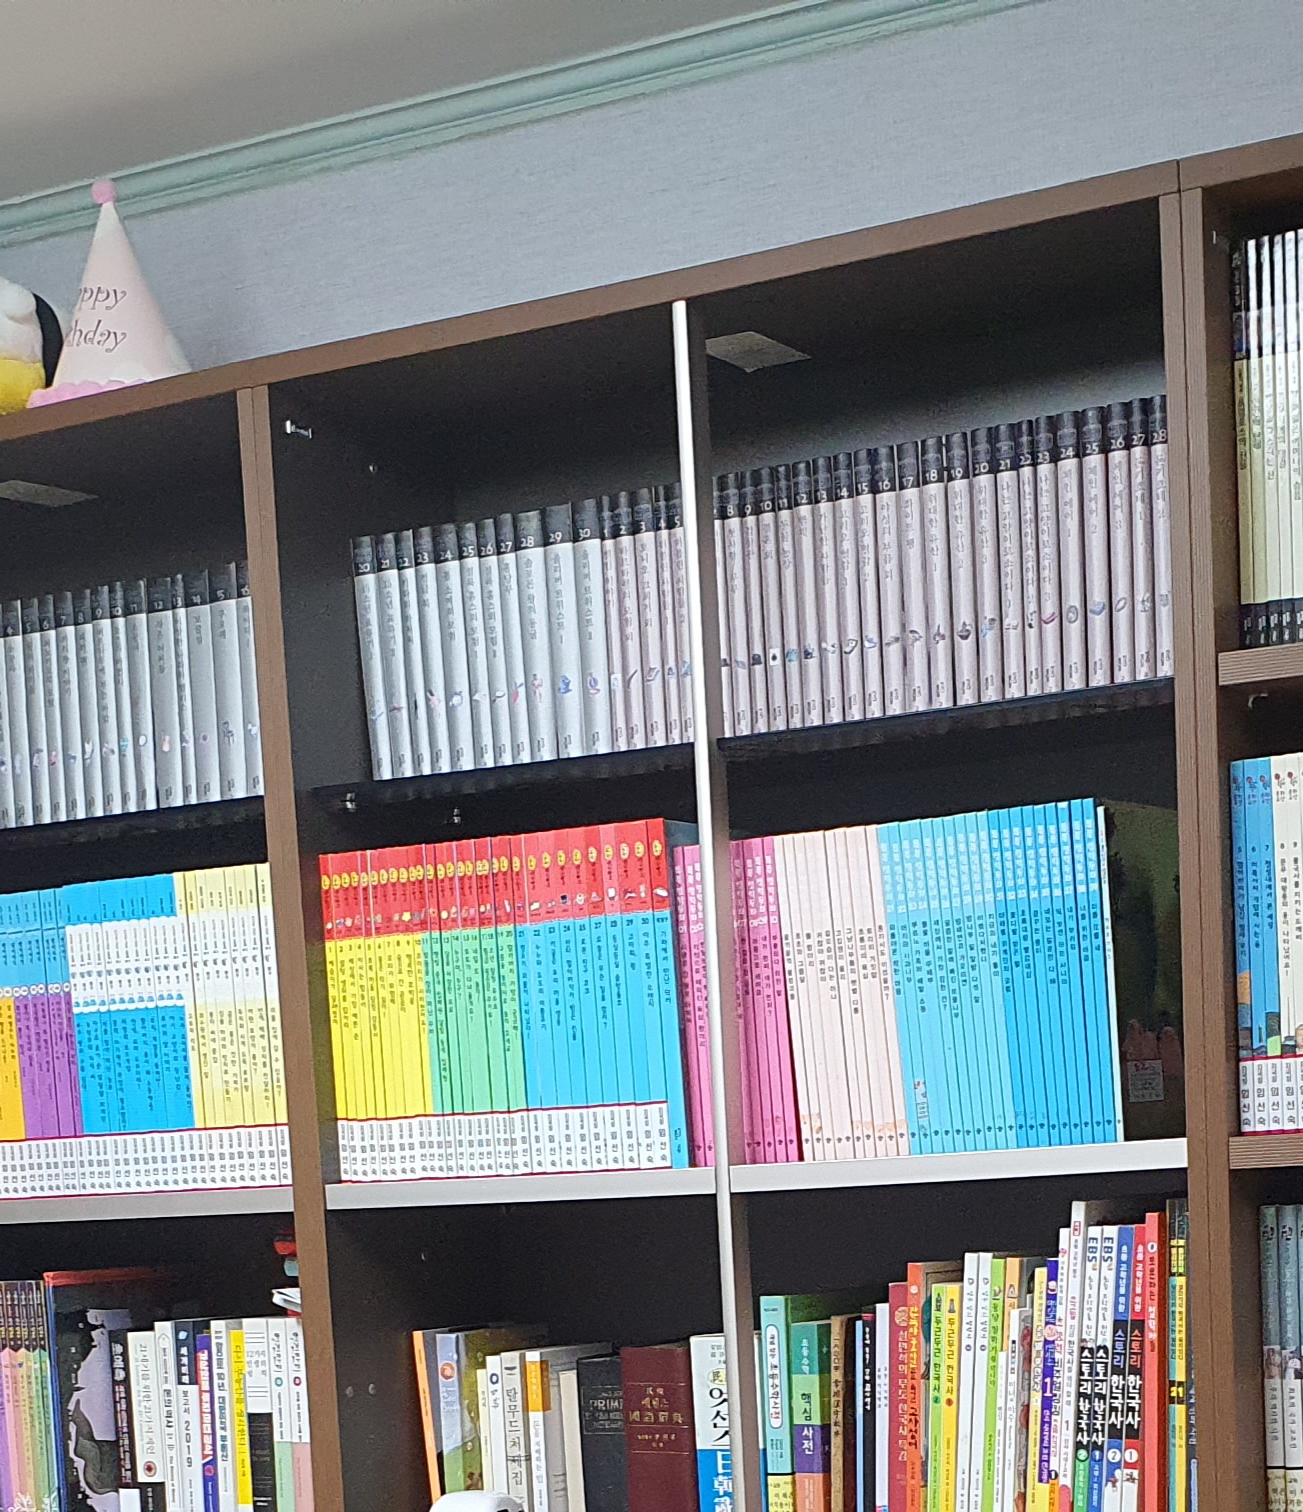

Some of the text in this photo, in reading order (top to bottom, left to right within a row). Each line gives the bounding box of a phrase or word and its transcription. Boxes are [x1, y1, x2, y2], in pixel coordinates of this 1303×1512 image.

[79, 286, 127, 310] ppy
[1132, 433, 1145, 445] 27
[1152, 430, 1167, 442] 28
[1110, 437, 1125, 449] 26
[1060, 447, 1074, 459] 24
[1085, 444, 1099, 455] 25
[1019, 455, 1032, 465] 22
[1037, 453, 1050, 463] 23
[974, 463, 989, 474] 20
[999, 460, 1010, 470] 21
[925, 470, 938, 481] 18
[951, 468, 963, 479] 19
[878, 479, 891, 490] 16
[902, 477, 913, 488] 17
[550, 532, 562, 542] 29
[578, 529, 591, 539] 30
[521, 536, 534, 547] 28
[1088, 1237, 1098, 1262] EBS
[1103, 1237, 1114, 1262] EBS
[932, 1318, 943, 1393] 두근두근 한국사
[946, 1318, 955, 1395] 두근두근 한국사
[1109, 1329, 1125, 1429] 스토리 한국사
[1125, 1328, 1143, 1429] 스토리 한국사
[1076, 1349, 1093, 1445] 스토리 한국사
[1092, 1349, 1109, 1445] 스토리 한국사
[801, 1393, 812, 1422] 핵심
[184, 1421, 194, 1467] 2019
[802, 1427, 814, 1454] 사전
